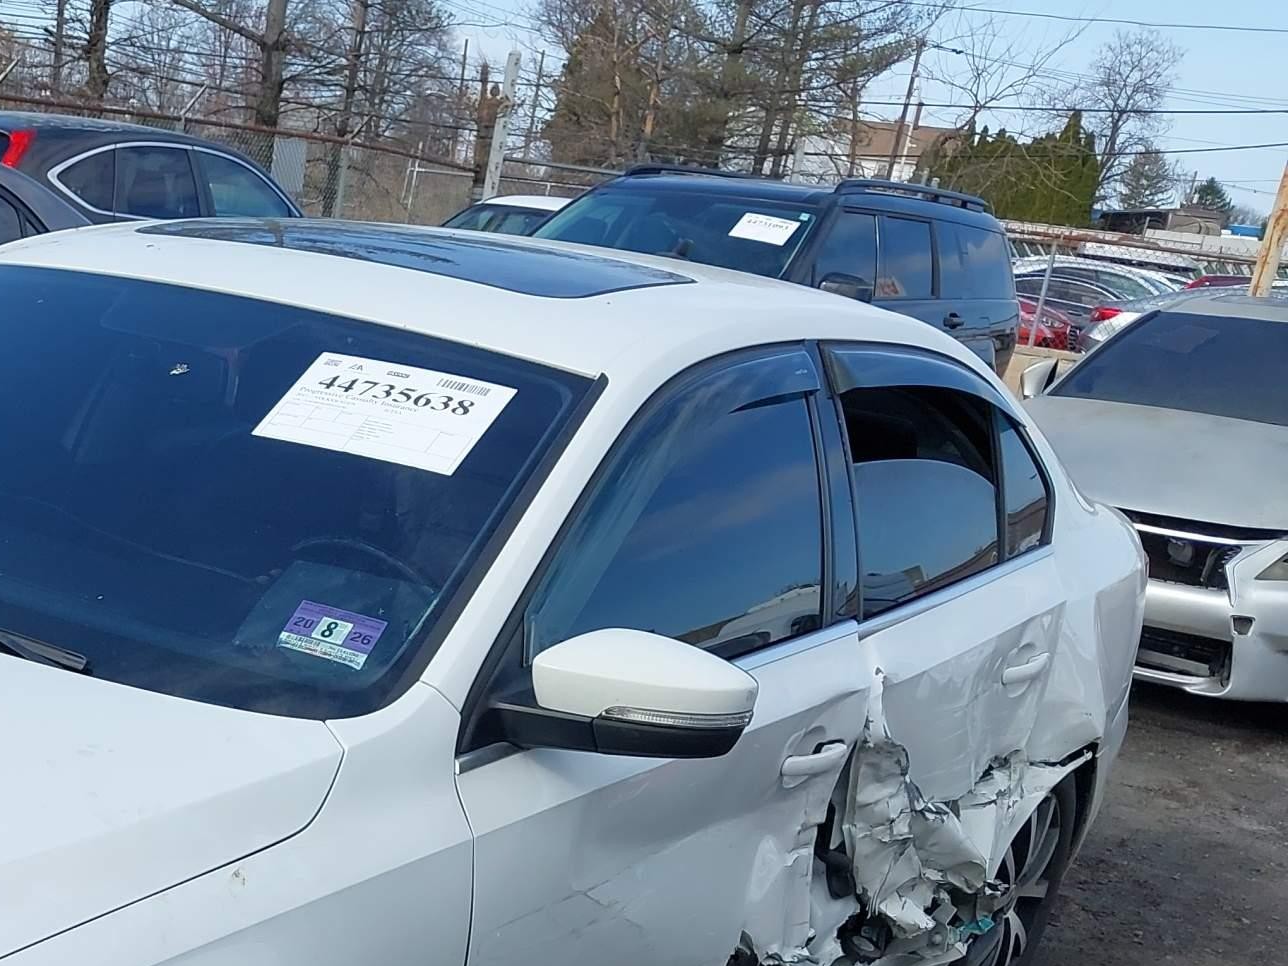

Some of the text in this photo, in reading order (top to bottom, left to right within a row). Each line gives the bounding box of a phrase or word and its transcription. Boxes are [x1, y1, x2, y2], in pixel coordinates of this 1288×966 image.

[299, 386, 344, 399] Progressive
[345, 393, 378, 405] Casualty
[318, 375, 475, 416] 44735638
[293, 616, 373, 646] 20 8 26
